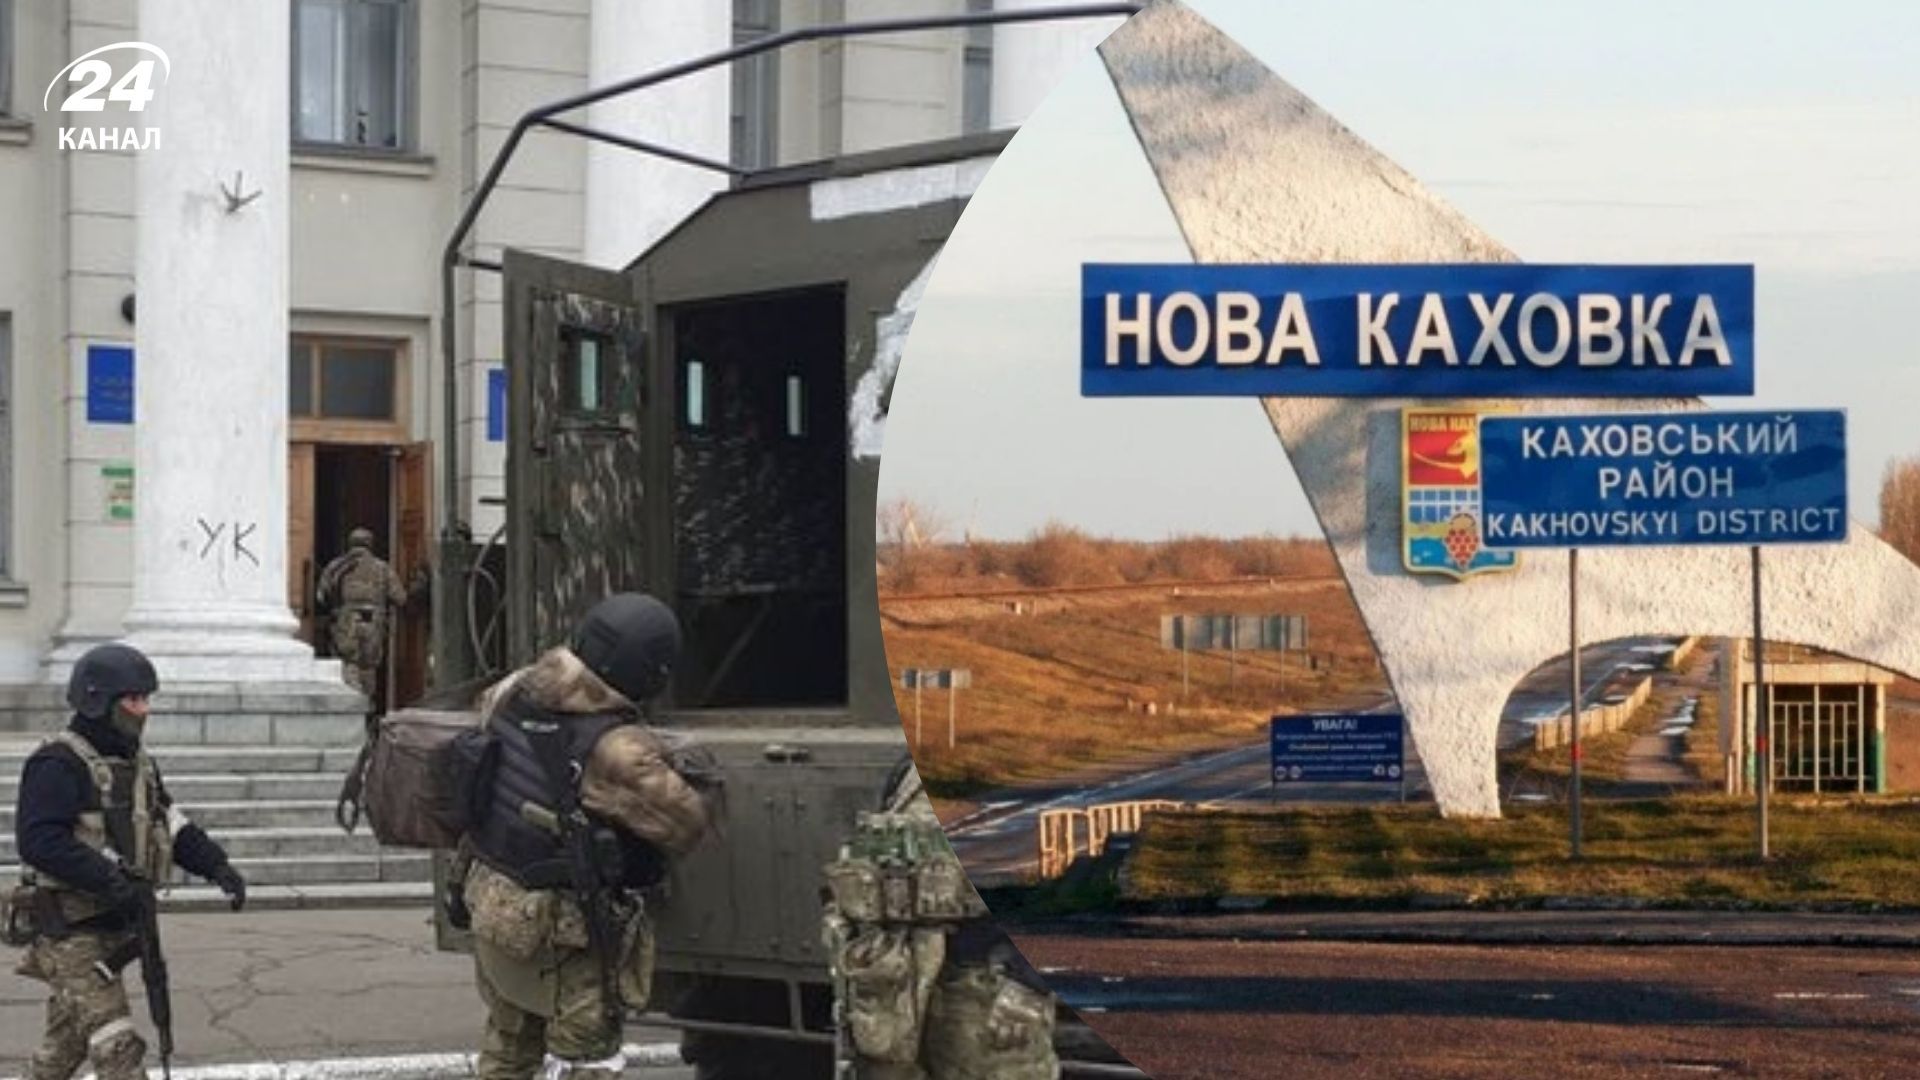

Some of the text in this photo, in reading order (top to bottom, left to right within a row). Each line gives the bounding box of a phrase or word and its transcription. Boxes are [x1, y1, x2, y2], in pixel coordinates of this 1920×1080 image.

[1104, 291, 1733, 366] НОВА КАХОВКА
[1521, 415, 1799, 458] КАХОВСЬКИЙ
[1599, 463, 1734, 499] РАЙОН
[1487, 508, 1840, 537] KAKHOVSKYI DISTRICT
